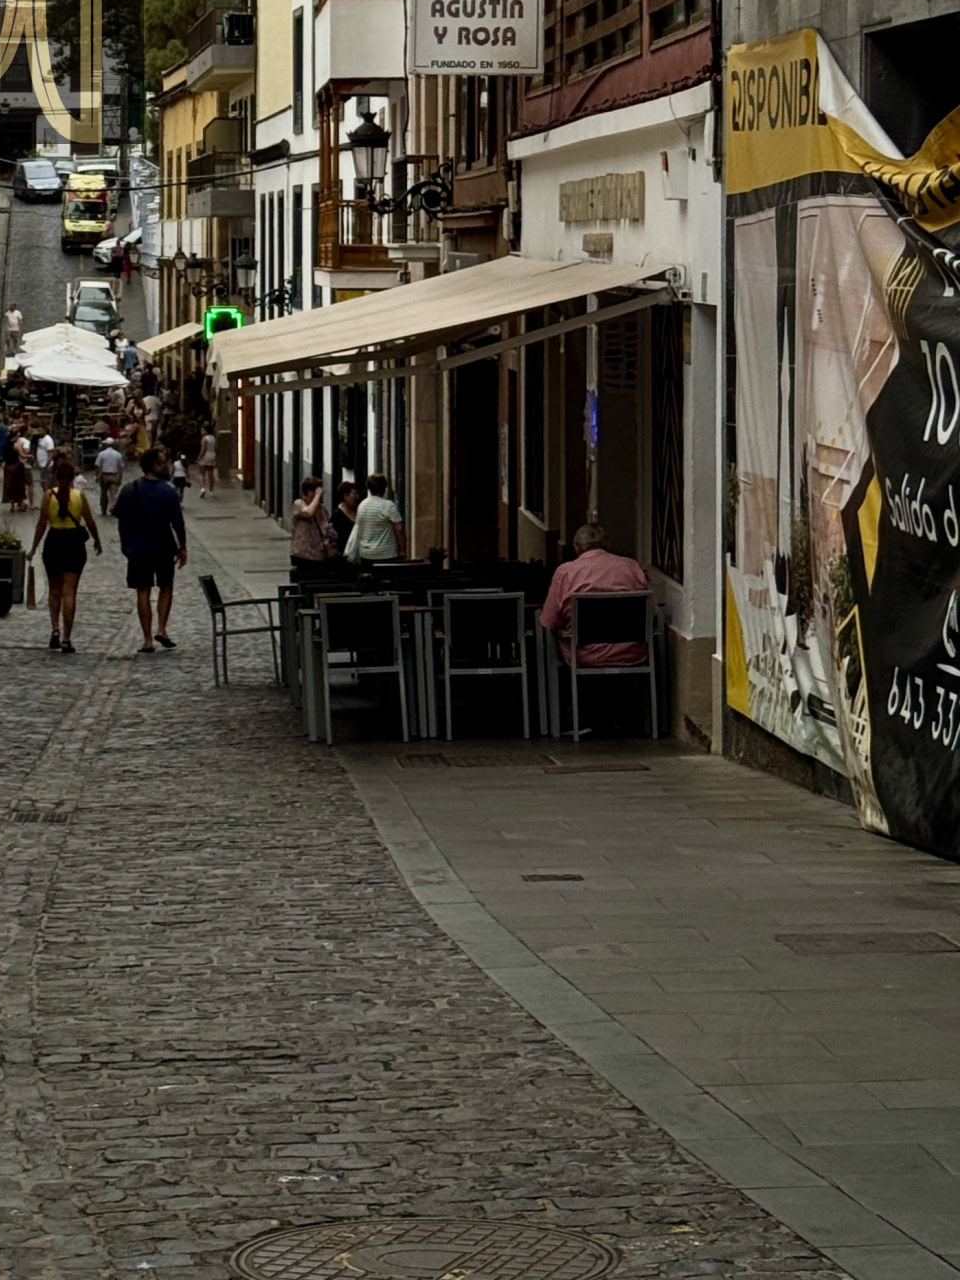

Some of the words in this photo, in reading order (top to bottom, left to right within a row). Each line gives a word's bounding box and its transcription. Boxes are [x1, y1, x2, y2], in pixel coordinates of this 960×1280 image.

[430, 0, 525, 19] AGUSTIN
[433, 26, 448, 45] Y
[457, 26, 517, 47] ROSA
[430, 60, 476, 69] FUNDADO
[480, 61, 494, 69] EN
[497, 61, 520, 69] 1950
[885, 473, 938, 542] Salida
[888, 666, 925, 730] 643
